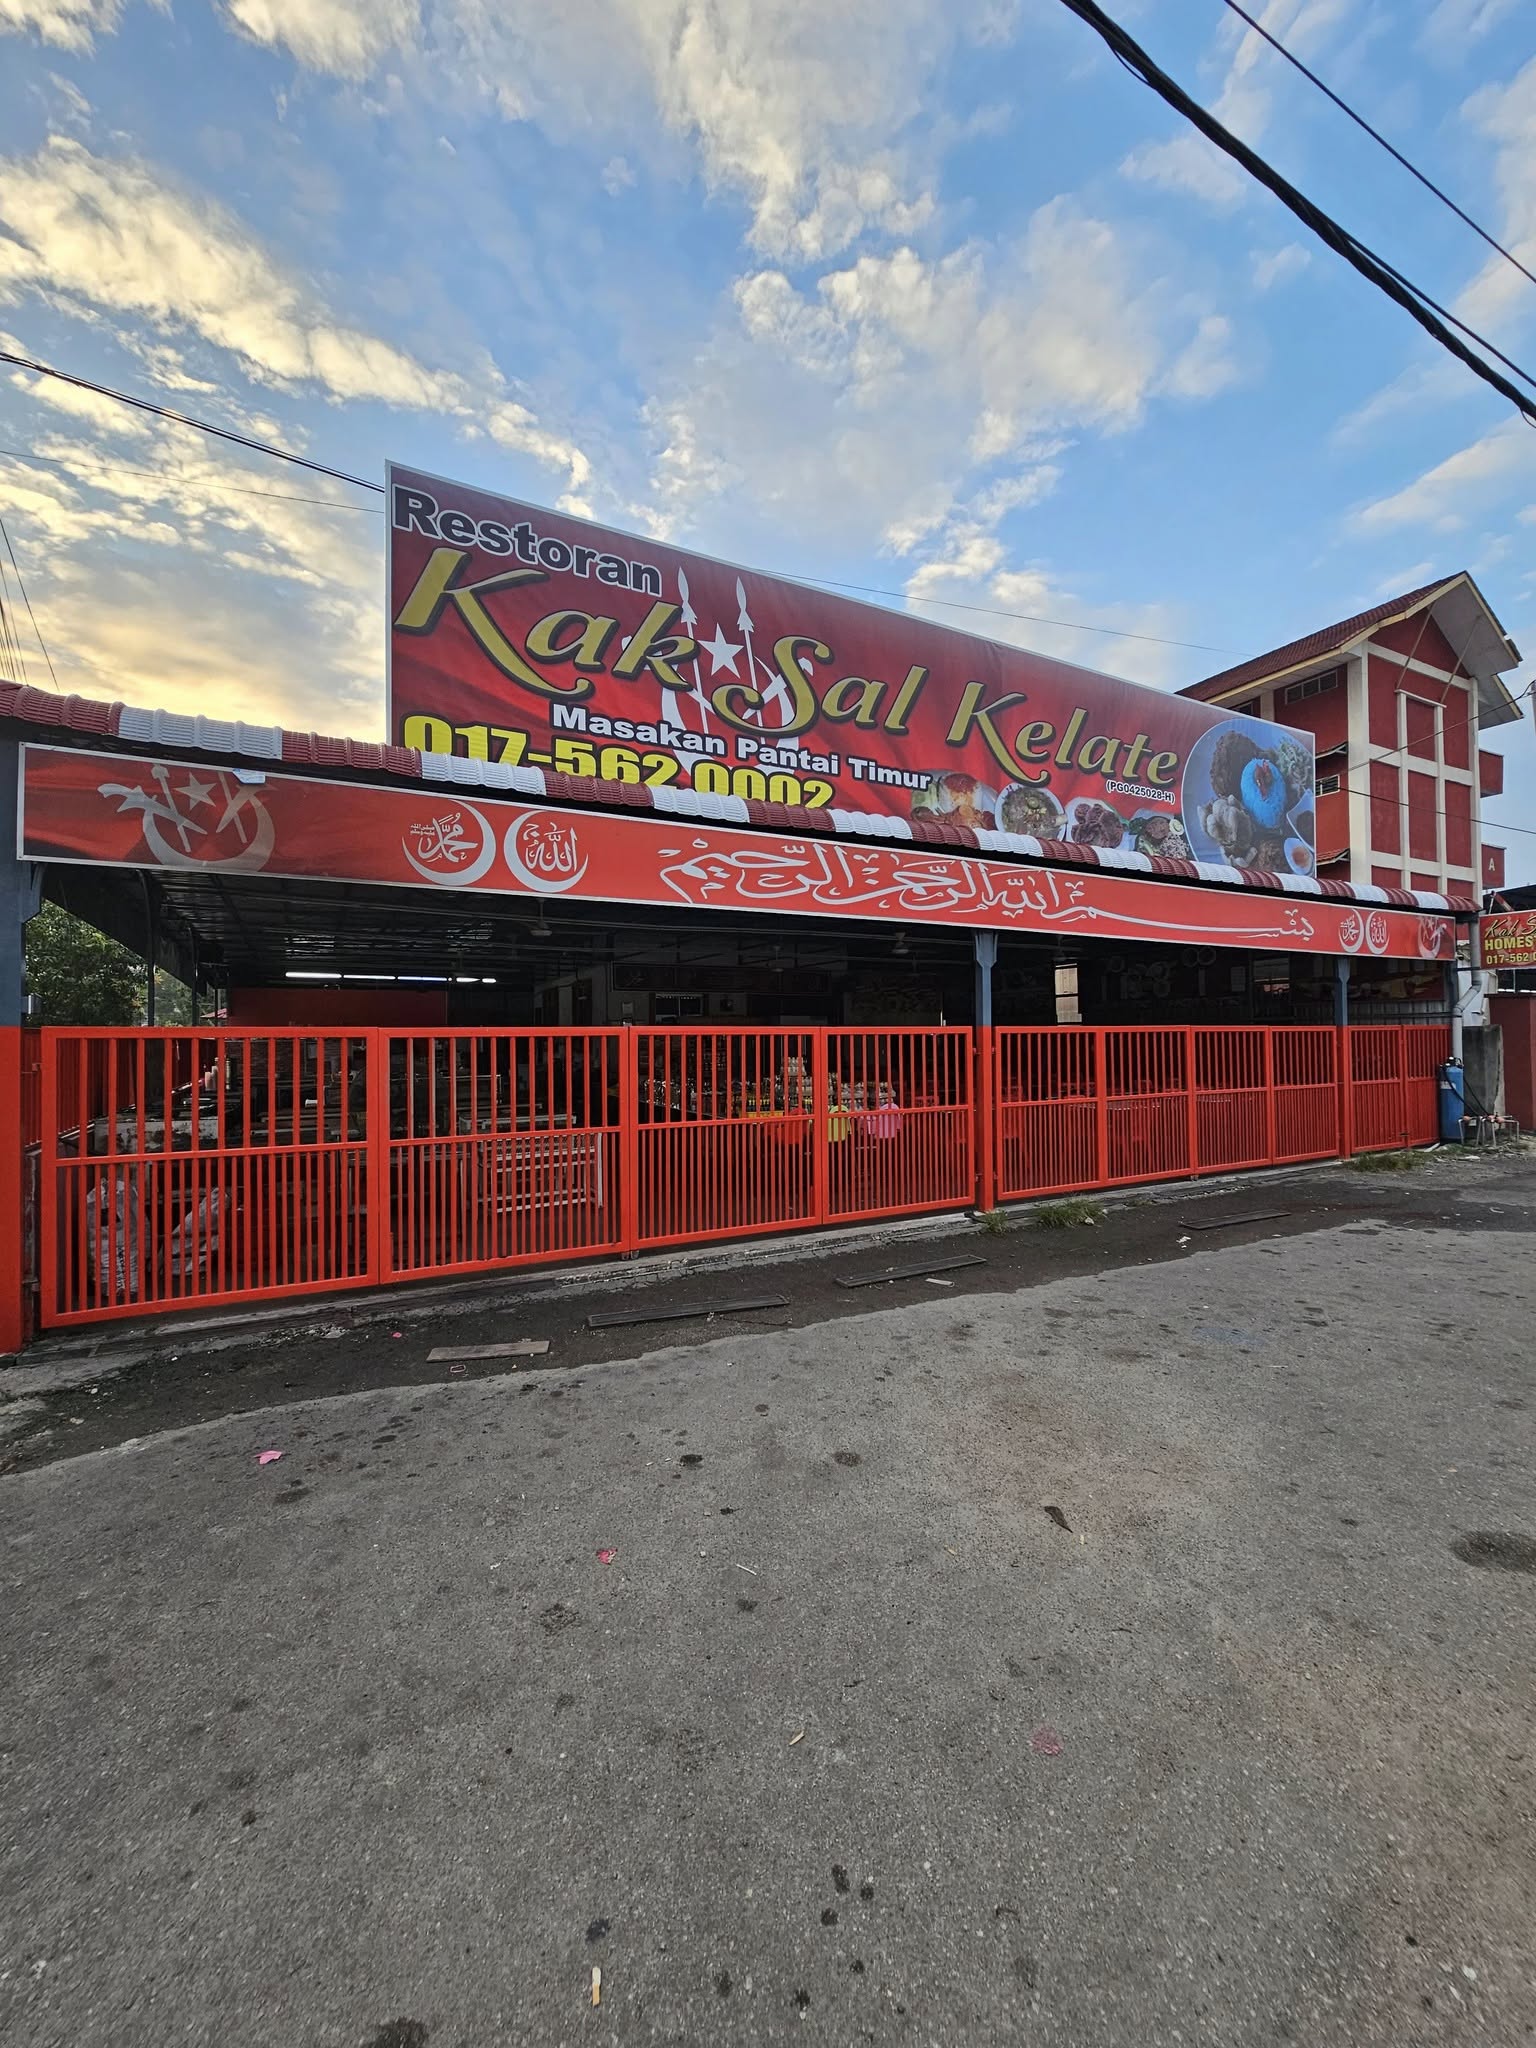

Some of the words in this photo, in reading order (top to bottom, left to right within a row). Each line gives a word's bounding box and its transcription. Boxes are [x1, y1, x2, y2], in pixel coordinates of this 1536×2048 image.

[393, 483, 663, 597] Restoran
[394, 547, 699, 700] Kak
[711, 634, 931, 737] Sal
[946, 681, 1181, 788] Kelate
[551, 702, 726, 757] Masakan
[736, 736, 840, 776] Pantai
[847, 756, 933, 791] Timur
[403, 714, 679, 789] 017-562
[693, 761, 834, 810] 0002
[1106, 779, 1176, 806] (PG0425028-H)
[1488, 857, 1496, 872] A
[1484, 918, 1520, 939] Kak
[1484, 935, 1536, 951] HOMES
[1486, 952, 1529, 965] 017-562
